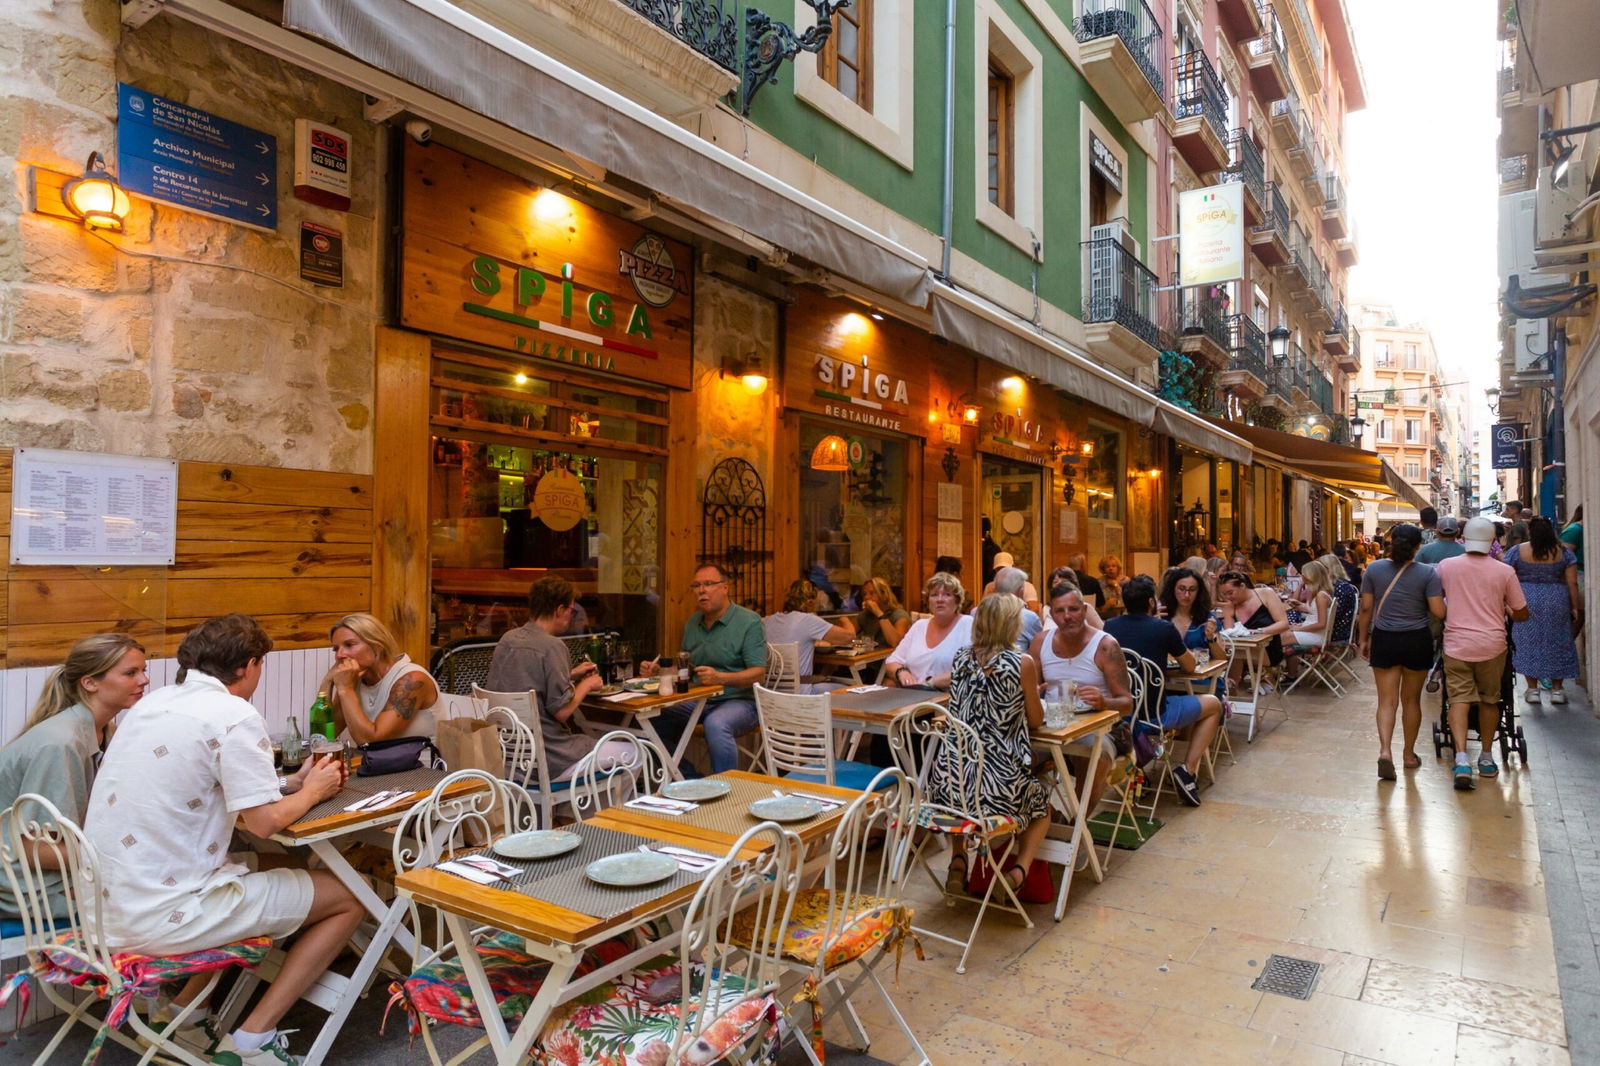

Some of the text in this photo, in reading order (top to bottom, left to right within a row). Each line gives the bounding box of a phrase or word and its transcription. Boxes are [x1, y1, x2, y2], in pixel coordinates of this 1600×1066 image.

[152, 97, 210, 123] Concatedral
[152, 107, 165, 116] de
[167, 111, 185, 123] San
[187, 118, 221, 135] Nicolás
[153, 138, 190, 156] Archivo
[192, 149, 235, 170] Municipal
[153, 165, 186, 180] Centro
[188, 175, 198, 184] 14
[160, 176, 169, 184] de
[170, 178, 201, 192] Recursos
[202, 188, 211, 196] de
[619, 248, 690, 296] PIZZA
[515, 335, 615, 370] PIZZERIA
[824, 404, 901, 431] RESTAURANTE
